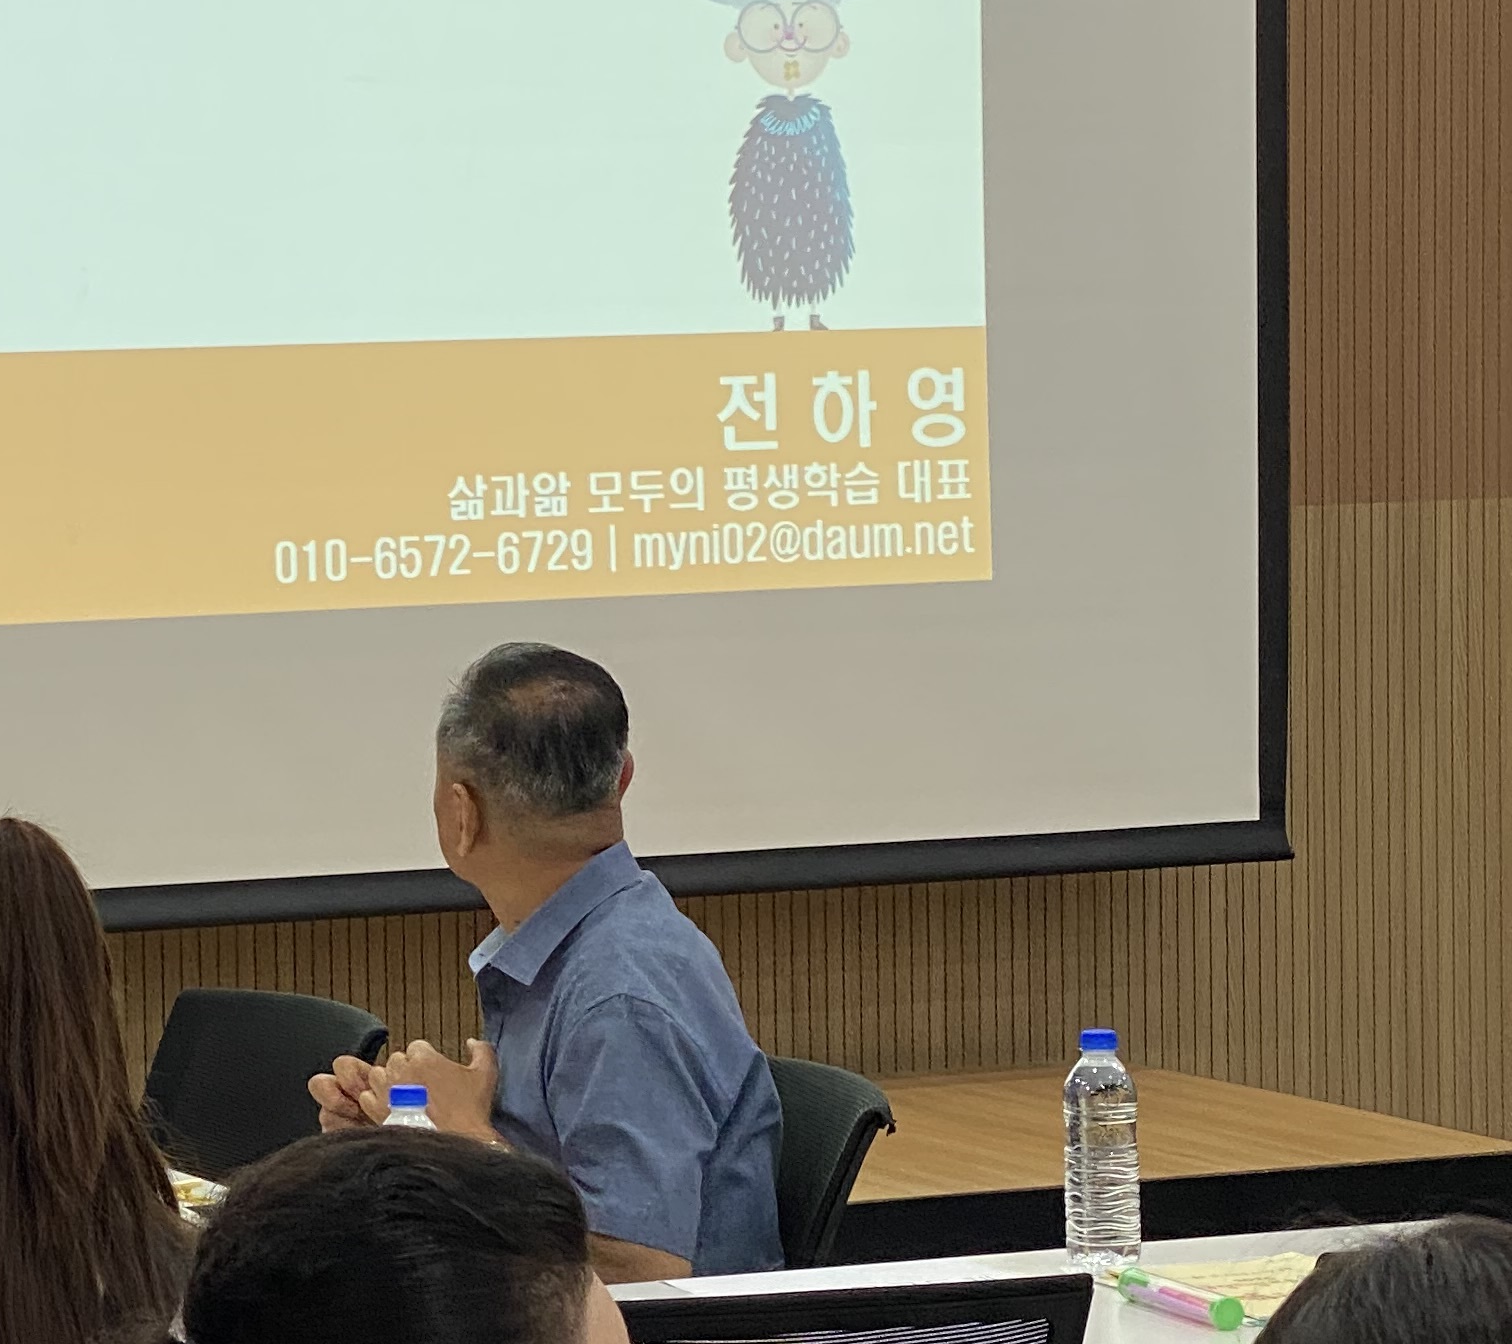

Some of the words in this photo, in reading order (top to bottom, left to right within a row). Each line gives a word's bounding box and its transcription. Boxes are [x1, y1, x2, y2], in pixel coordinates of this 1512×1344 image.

[447, 471, 572, 521] 삶과앎
[588, 466, 705, 514] 모두의
[723, 461, 880, 512] 평생학습
[897, 459, 972, 504] 대표
[274, 528, 593, 584] 010-6572-6729
[633, 514, 976, 571] myni02@daum.net
